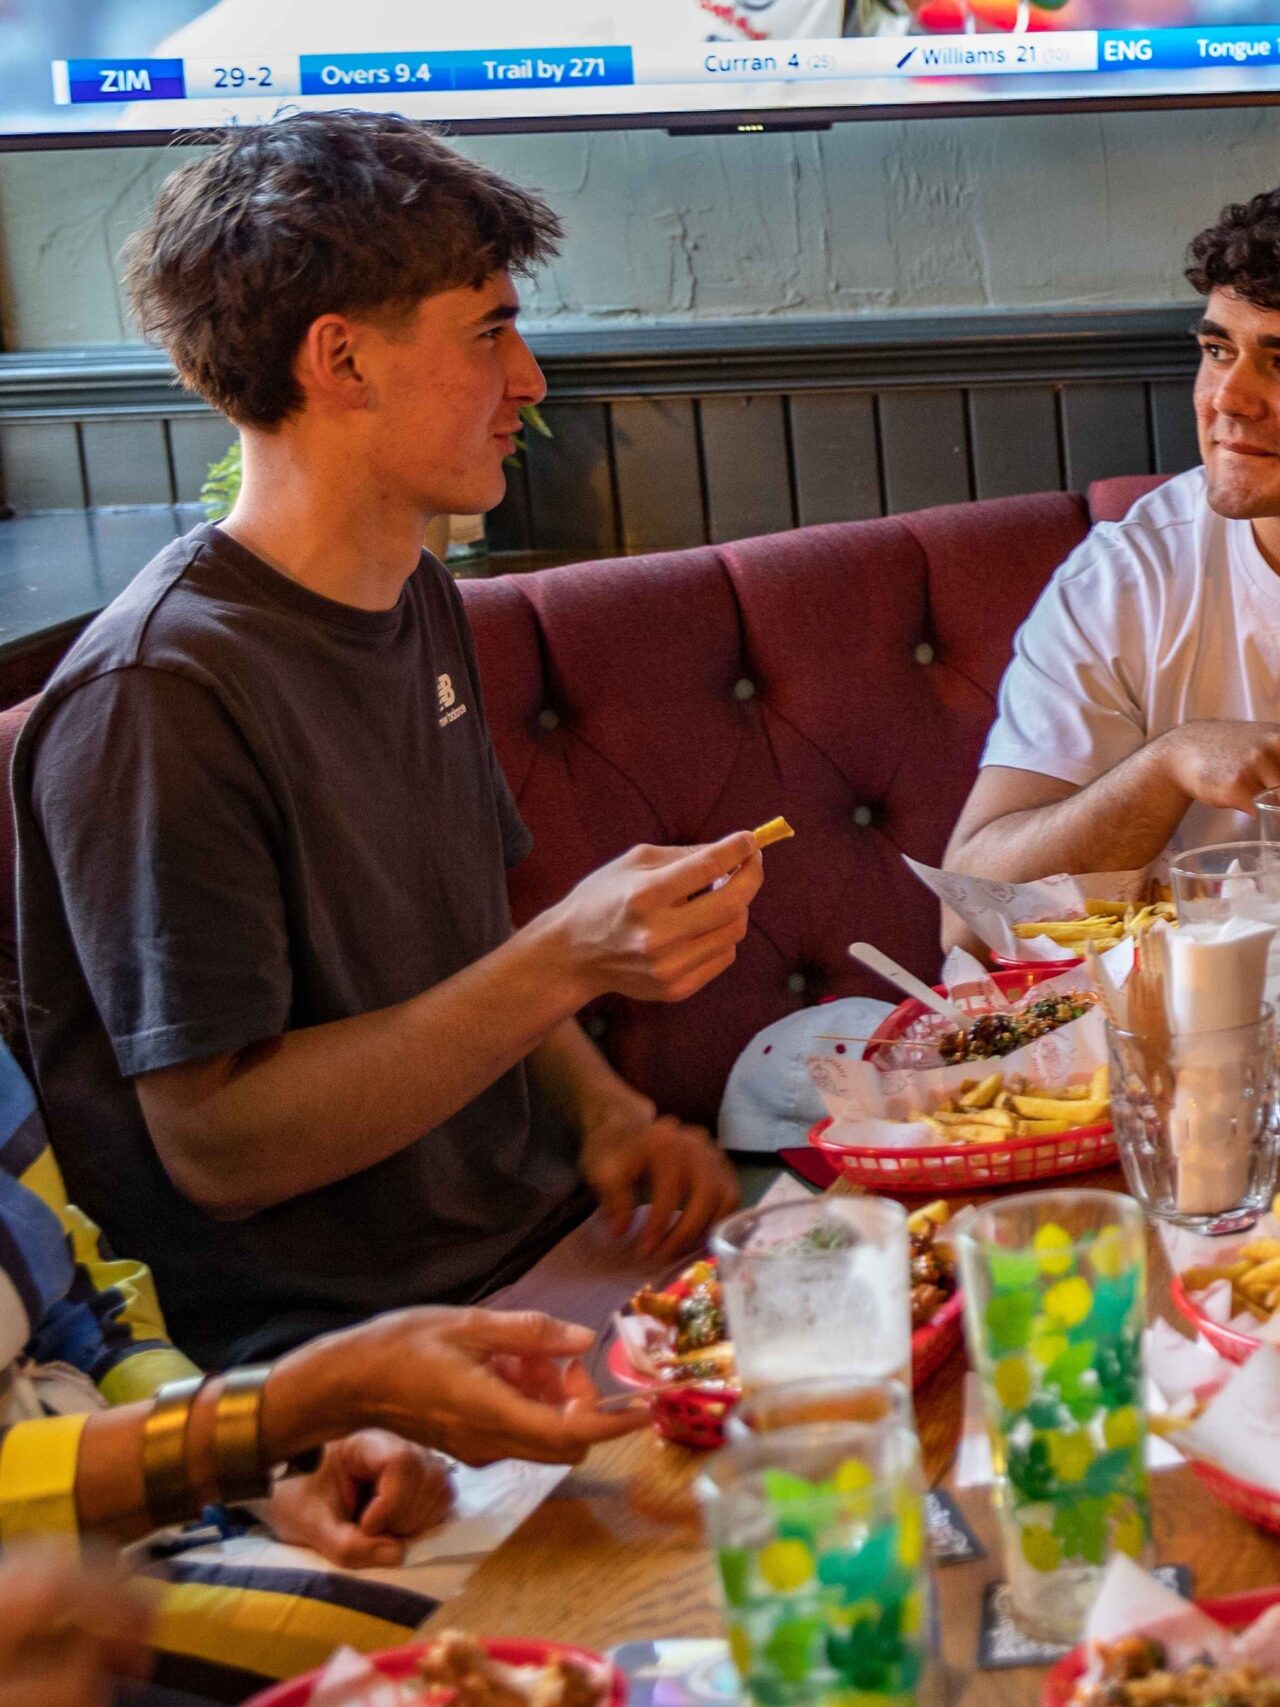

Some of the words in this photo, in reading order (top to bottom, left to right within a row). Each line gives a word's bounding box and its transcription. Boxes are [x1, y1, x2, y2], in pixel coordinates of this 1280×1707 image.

[922, 48, 1006, 65] Williams
[1016, 45, 1037, 63] 21
[1104, 39, 1153, 61] ENG
[1197, 38, 1271, 61] Tongue
[482, 59, 533, 80] Trail
[537, 59, 565, 83] by
[569, 57, 605, 77] 271
[704, 55, 777, 72] Curran
[788, 52, 799, 70] 4
[100, 69, 152, 92] ZIM
[213, 67, 272, 88] 29-2
[321, 65, 391, 85] Overs
[395, 63, 431, 82] 9.4
